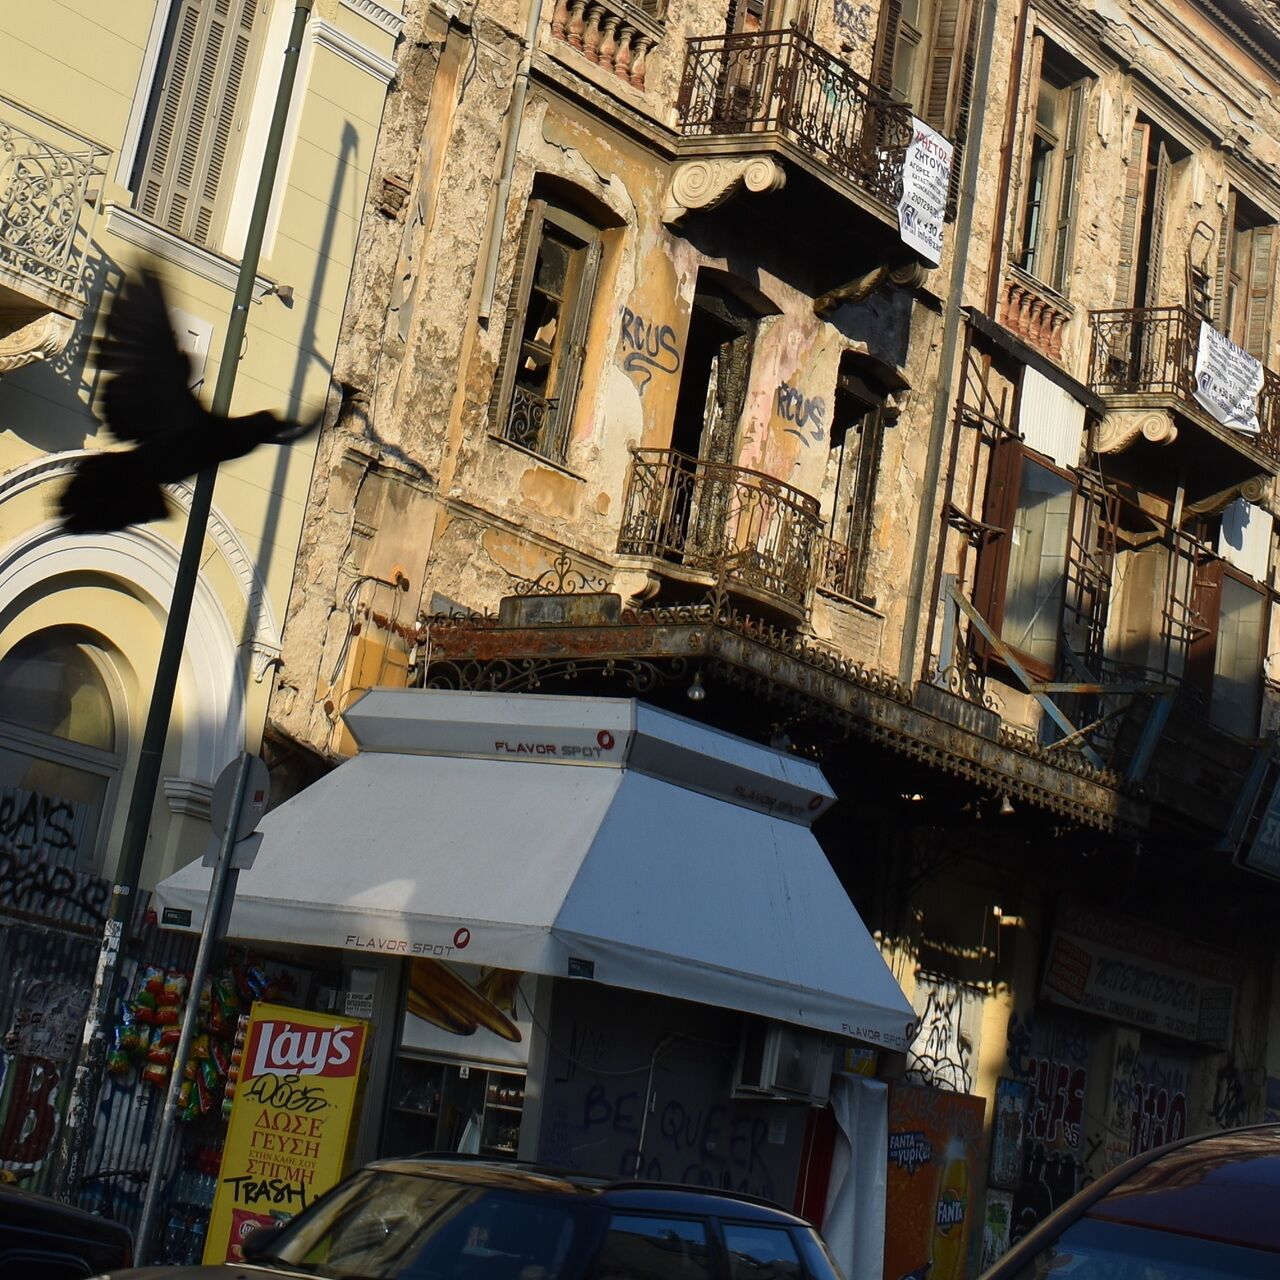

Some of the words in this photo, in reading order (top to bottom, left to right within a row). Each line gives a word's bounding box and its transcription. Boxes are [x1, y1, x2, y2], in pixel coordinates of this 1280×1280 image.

[495, 741, 556, 755] FLAVOR
[561, 745, 603, 757] SPOT
[345, 935, 407, 951] FLAVOR
[411, 943, 454, 956] SPOT
[842, 1023, 880, 1040] FLAVOR
[883, 1032, 907, 1047] SPOT
[255, 1109, 323, 1138] ΔΩΣΕ
[584, 1083, 640, 1136] BE
[660, 1099, 772, 1188] QUEER
[250, 1130, 321, 1158] ΓΕΥΣΗ
[890, 1134, 915, 1149] FANTA
[246, 1159, 315, 1184] ΣΤΙΓΜΗ
[249, 1150, 273, 1162] ΣΤΗΝ
[274, 1153, 298, 1166] ΚΑΘΕ
[299, 1159, 317, 1169] ΣΟΥ
[937, 1200, 964, 1224] FANTA
